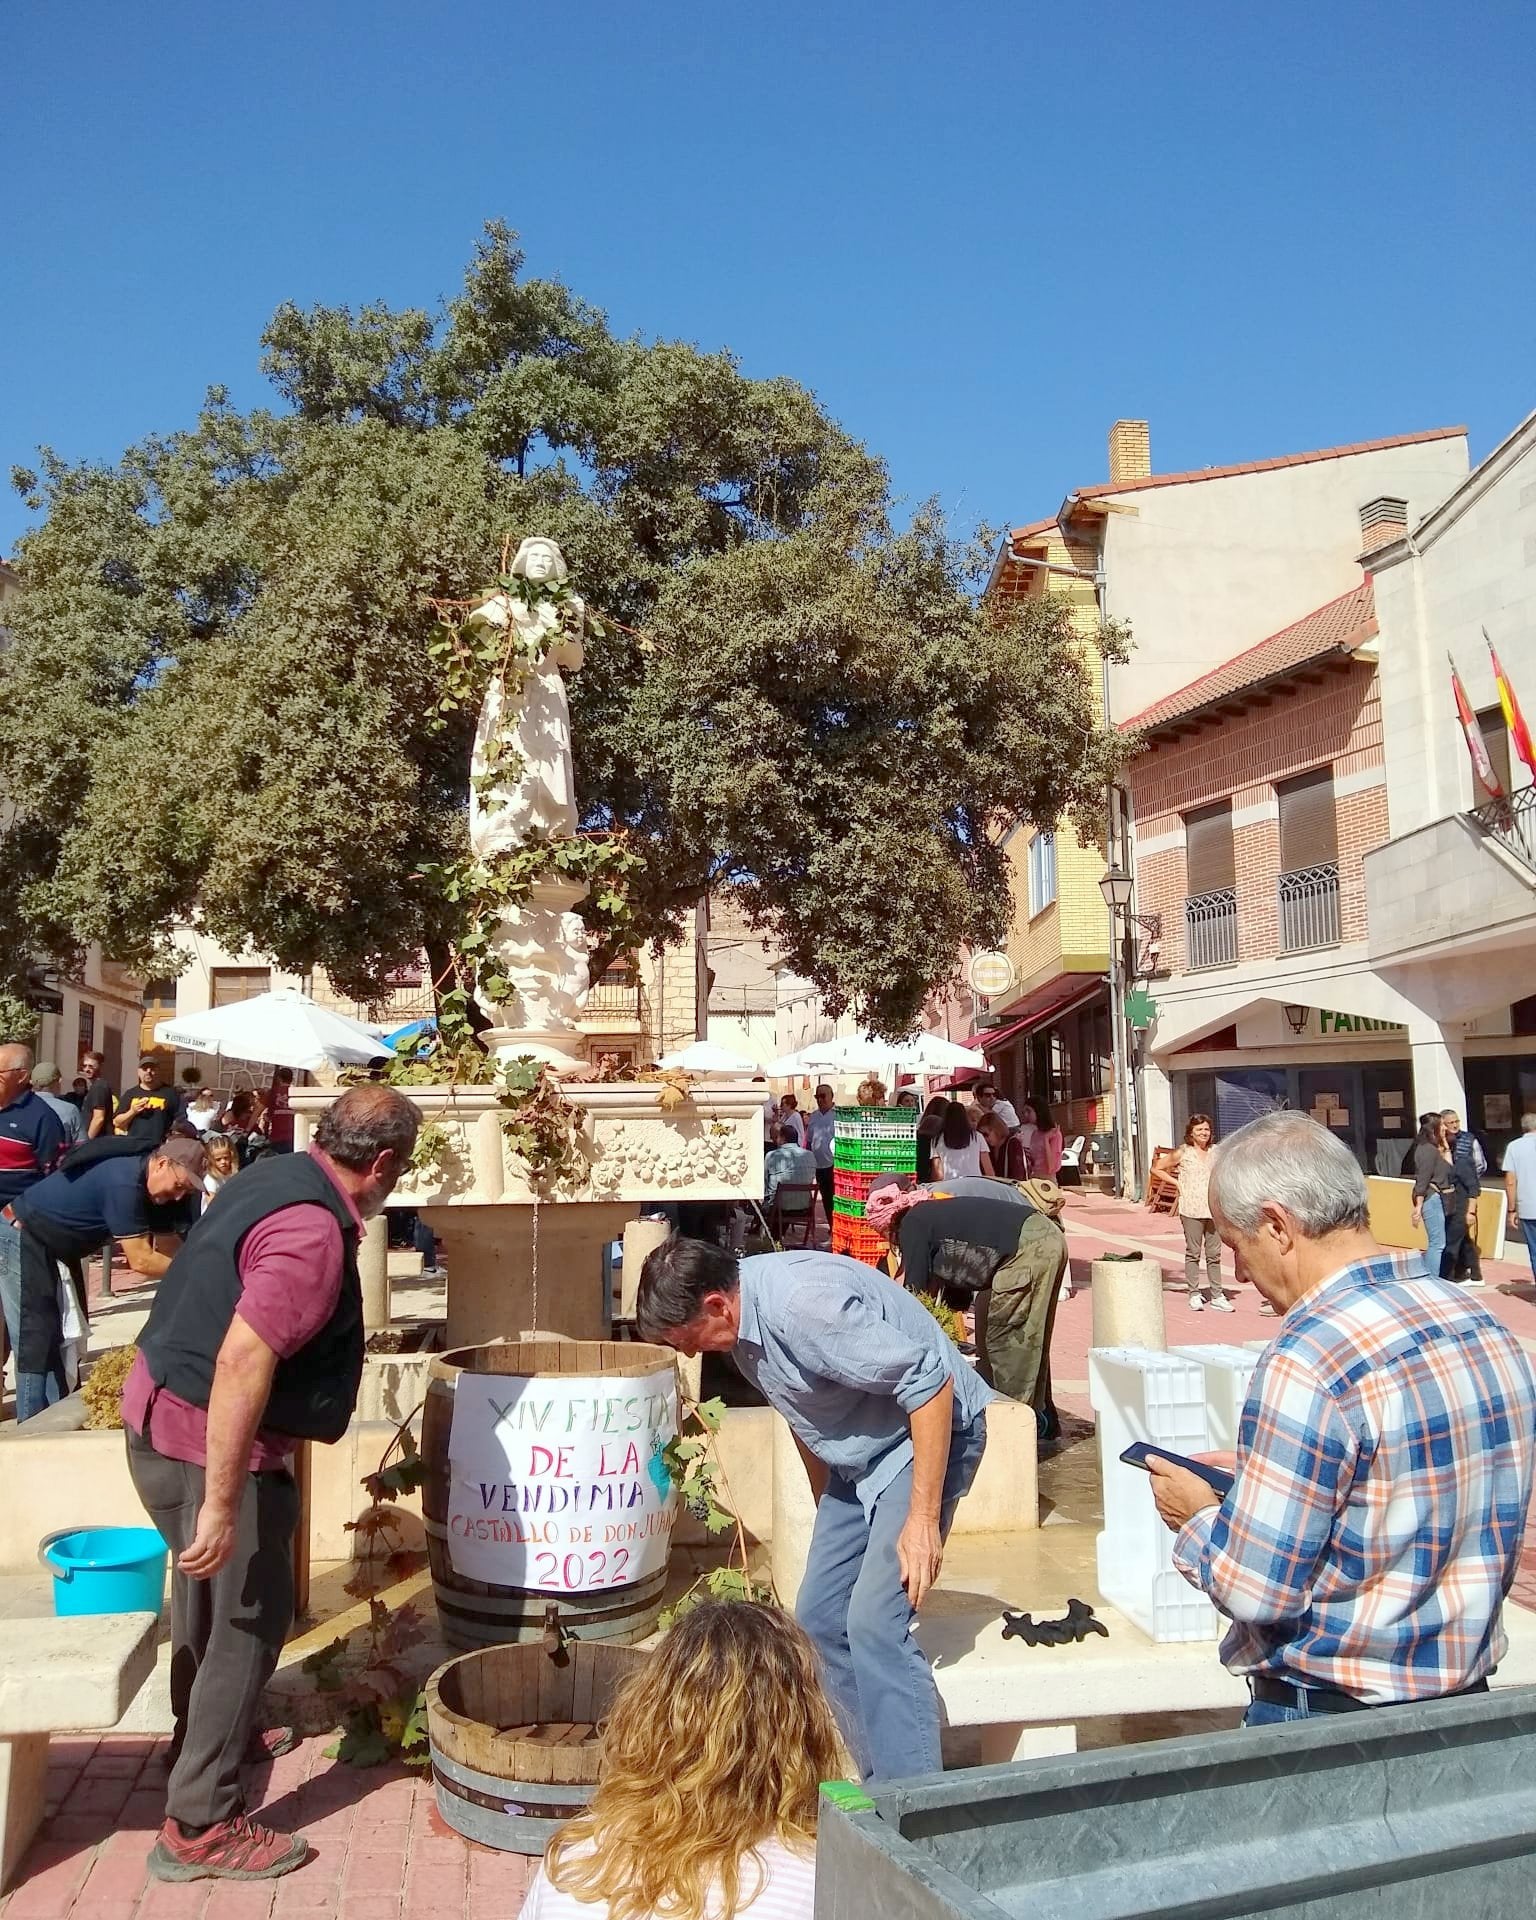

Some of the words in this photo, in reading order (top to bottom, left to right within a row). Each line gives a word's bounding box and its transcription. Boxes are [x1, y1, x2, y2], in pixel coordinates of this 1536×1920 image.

[488, 1397, 553, 1432] XIV
[565, 1392, 670, 1433] FIESTA
[529, 1445, 575, 1478] DE
[597, 1441, 640, 1477] LA
[479, 1480, 644, 1513] VENDIMIA
[569, 1525, 593, 1543] DE
[604, 1521, 638, 1543] DON
[534, 1547, 630, 1590] 2022
